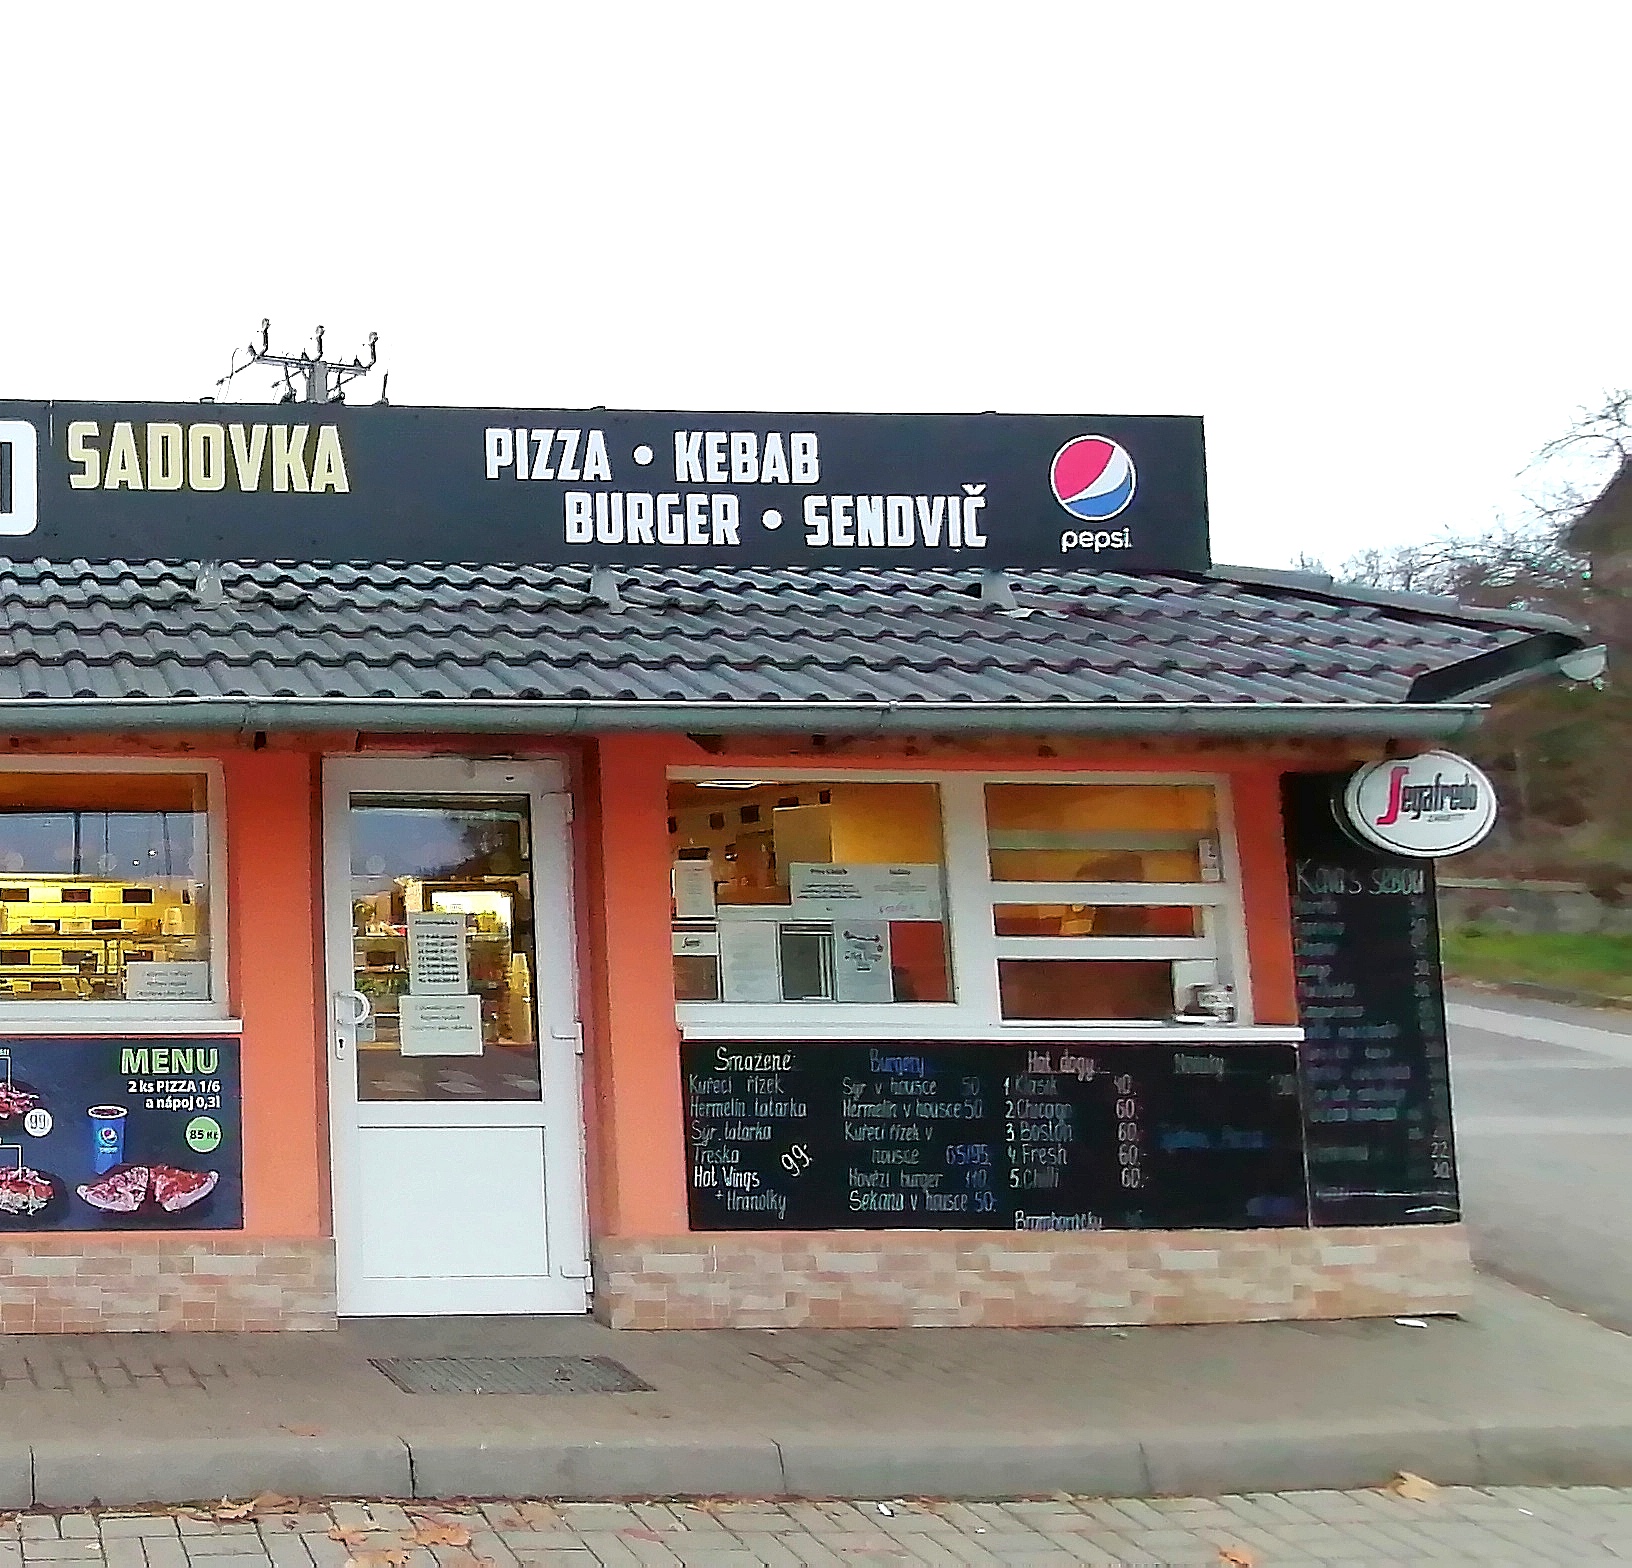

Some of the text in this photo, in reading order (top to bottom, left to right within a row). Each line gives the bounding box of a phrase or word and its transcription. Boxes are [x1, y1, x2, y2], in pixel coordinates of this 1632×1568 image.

[67, 420, 352, 494] SADOVKA
[484, 427, 820, 485] PIZZA KEBAB
[564, 484, 988, 549] BURGER SENDVIČ
[1060, 527, 1133, 554] pepsi
[1376, 766, 1478, 825] Segafredo
[121, 1047, 219, 1075] MENU
[1028, 1050, 1052, 1074] Hot
[128, 1080, 221, 1093] 2 ks PIZZA 1/6
[145, 1098, 154, 1109] a
[156, 1096, 194, 1112] nápoj
[190, 1129, 204, 1140] 85
[1021, 1143, 1069, 1166] Fresh
[694, 1164, 761, 1192] Hot Wings
[727, 1188, 787, 1220] Hranolky
[910, 1193, 919, 1212] v
